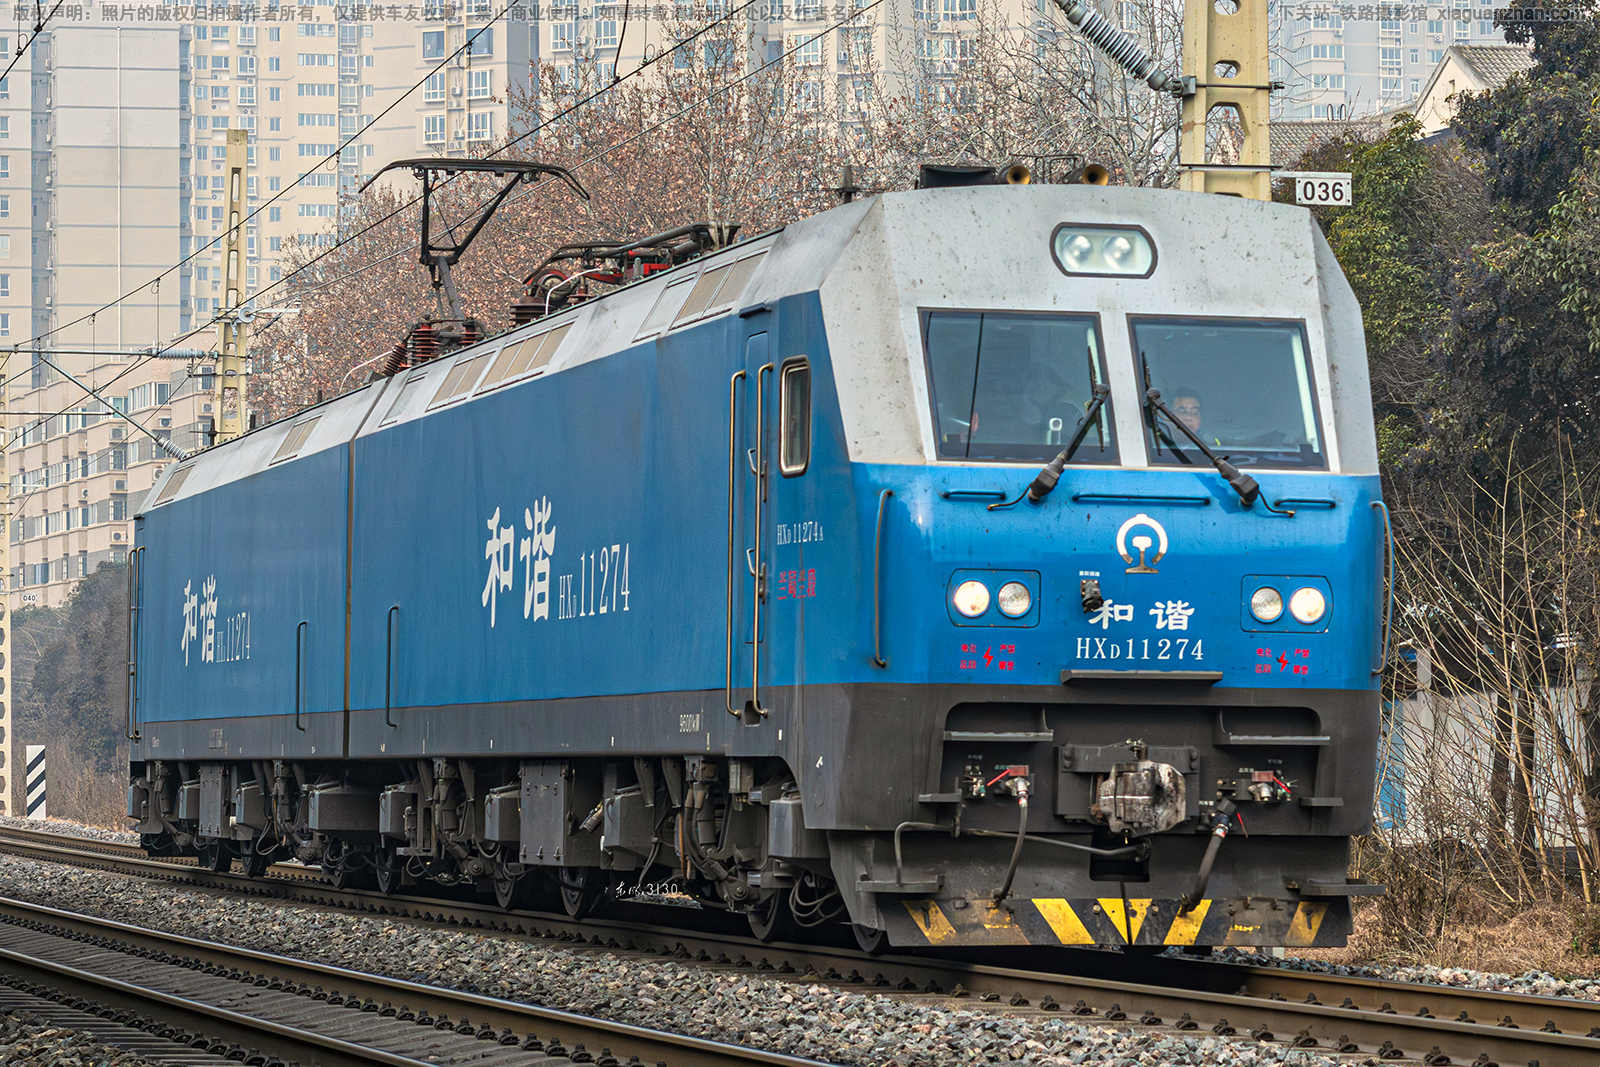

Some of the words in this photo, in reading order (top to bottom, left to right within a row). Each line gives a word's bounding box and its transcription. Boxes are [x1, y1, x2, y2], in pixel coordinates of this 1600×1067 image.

[1303, 180, 1344, 202] 036
[481, 495, 556, 628] 和谐
[181, 573, 218, 667] 和谐
[1088, 599, 1196, 631] 和谐
[1075, 637, 1204, 660] HXD11274
